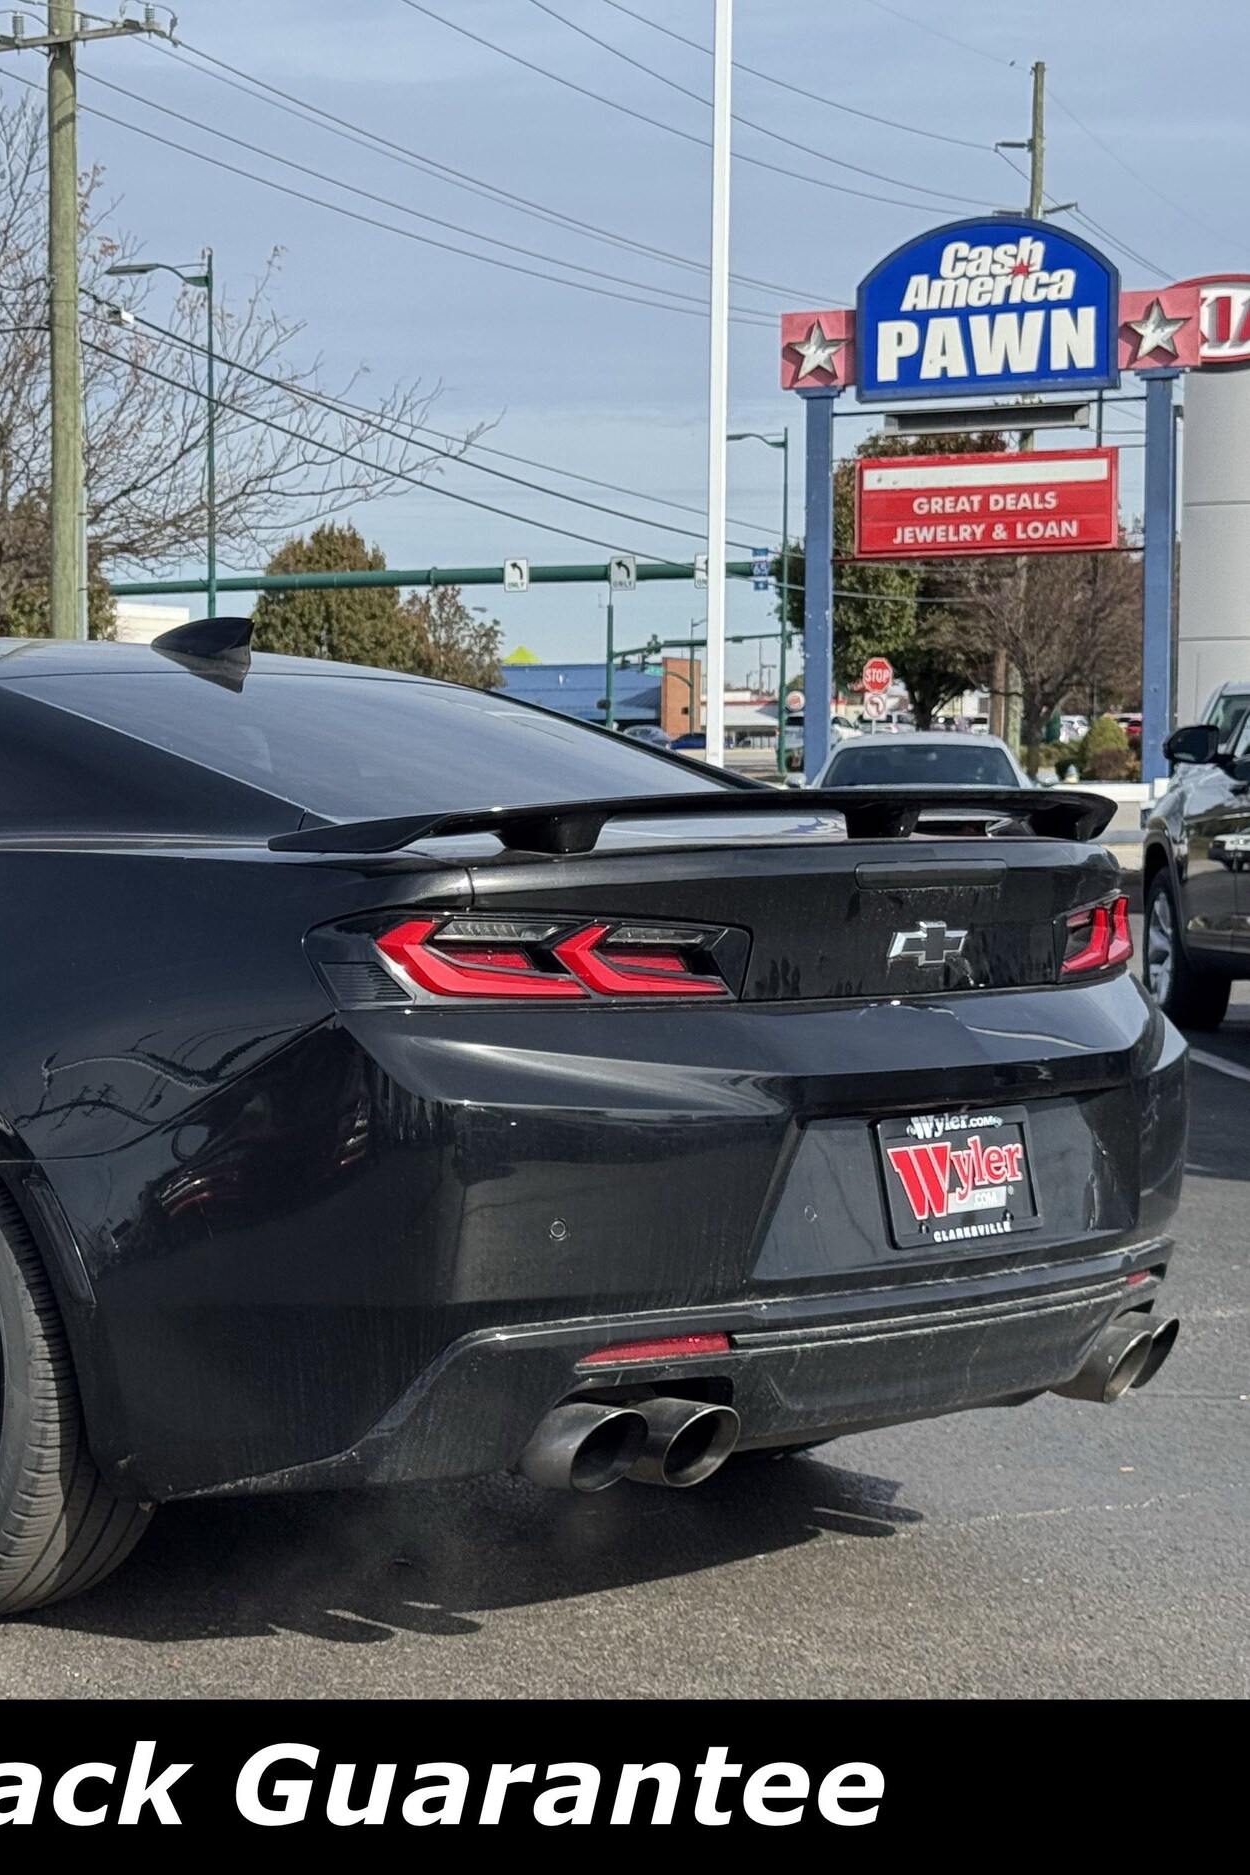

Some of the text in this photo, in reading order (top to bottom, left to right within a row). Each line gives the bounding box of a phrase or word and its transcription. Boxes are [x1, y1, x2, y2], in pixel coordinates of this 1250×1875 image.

[940, 236, 1045, 279] Cash
[900, 268, 1076, 312] America
[877, 306, 1096, 382] PAWN
[912, 491, 1057, 515] GREAT DEALS
[892, 520, 1079, 545] JEWELRY & LOAN
[612, 580, 632, 588] ONLY
[865, 668, 890, 683] STOP
[887, 1135, 1023, 1221] Wyler
[933, 1220, 1012, 1243] CLARKSVILLE
